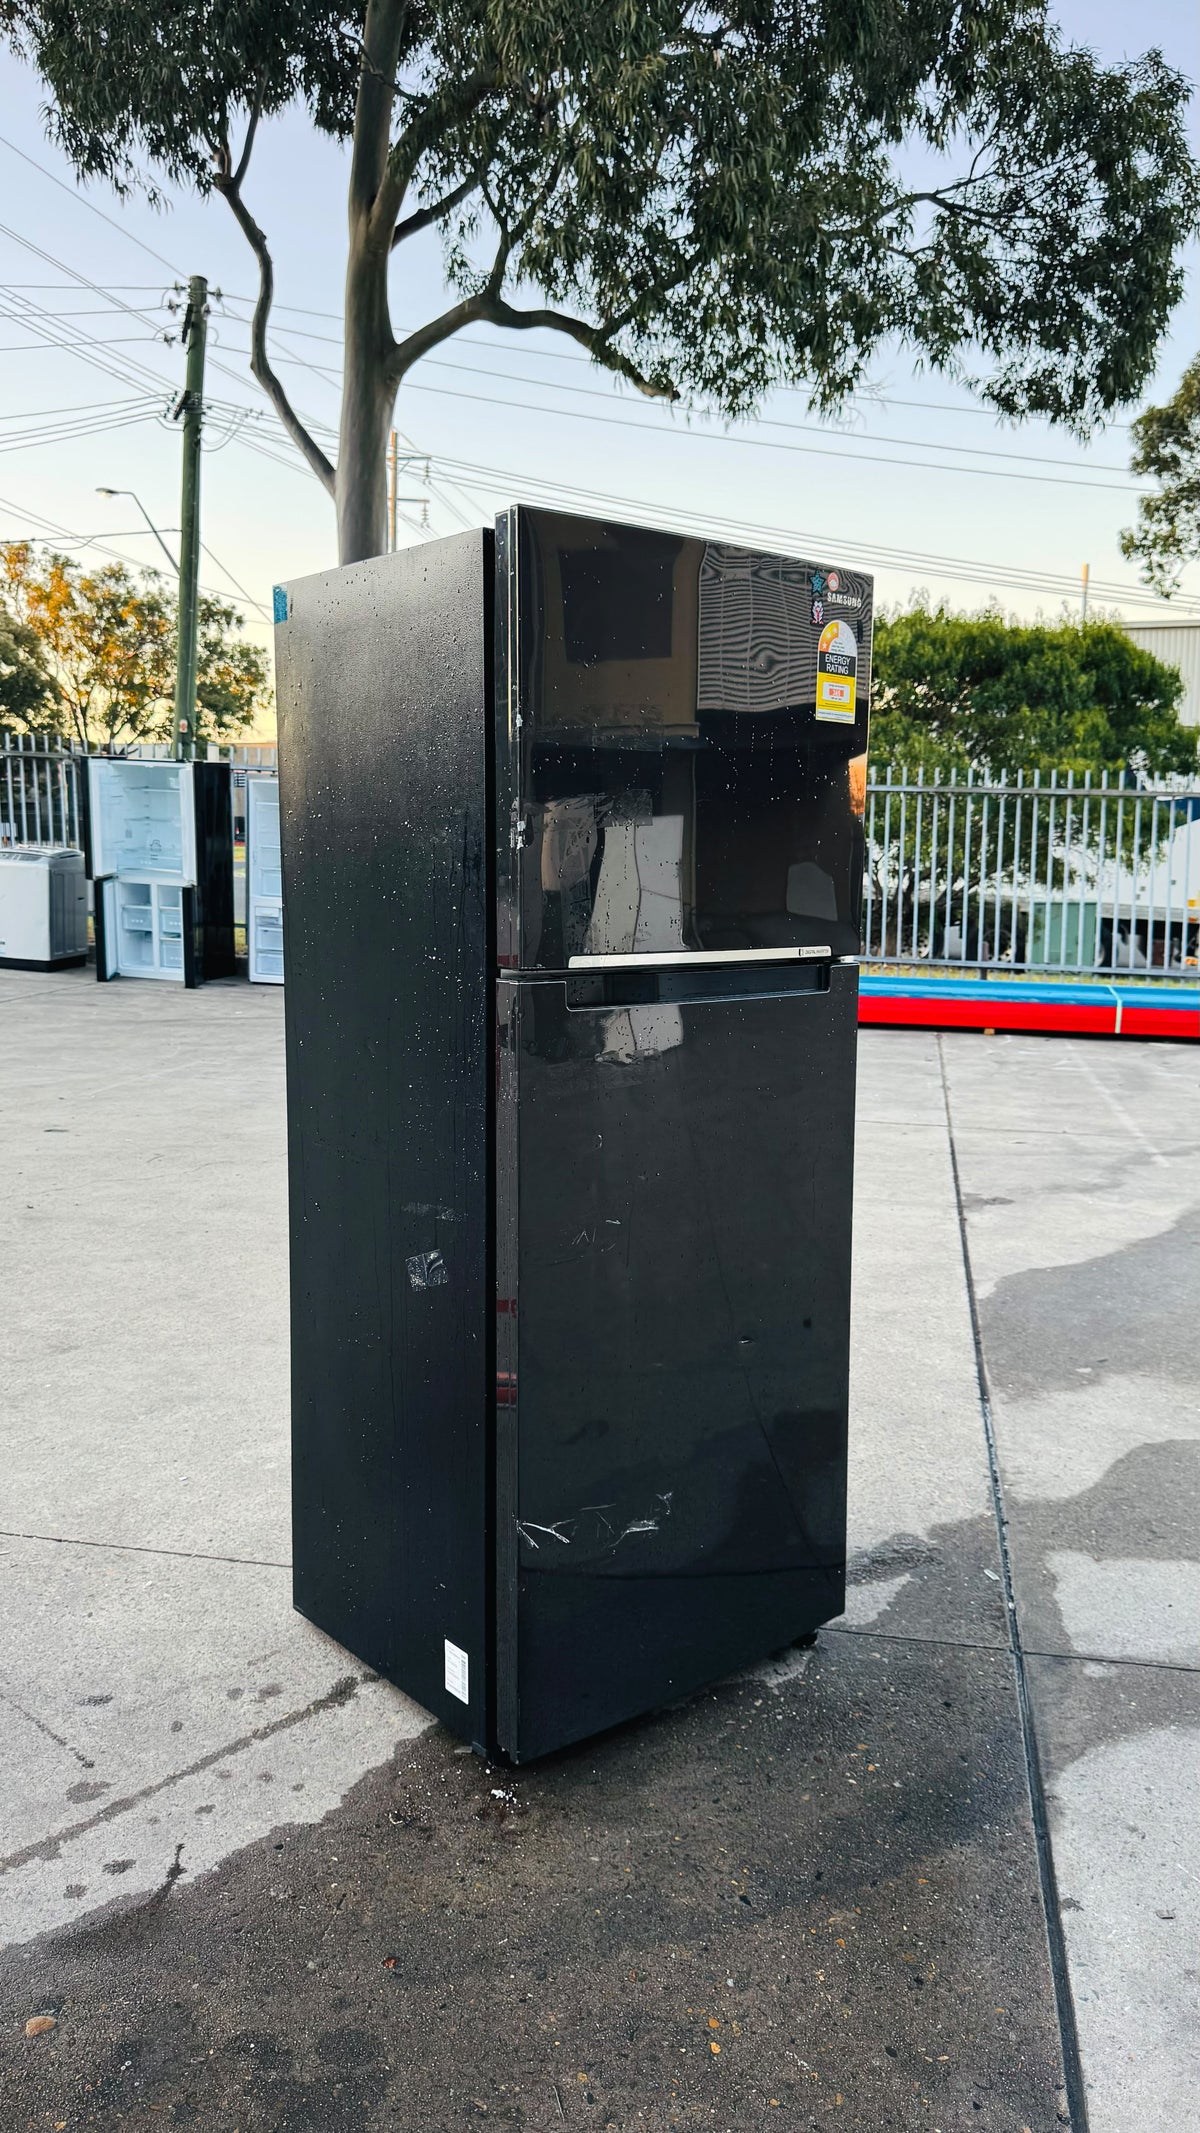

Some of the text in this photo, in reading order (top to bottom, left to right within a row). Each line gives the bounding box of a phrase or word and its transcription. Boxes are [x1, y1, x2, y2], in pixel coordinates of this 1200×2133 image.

[827, 592, 861, 608] SAMSUNG
[825, 654, 850, 665] ENERGY
[826, 664, 848, 674] RATING
